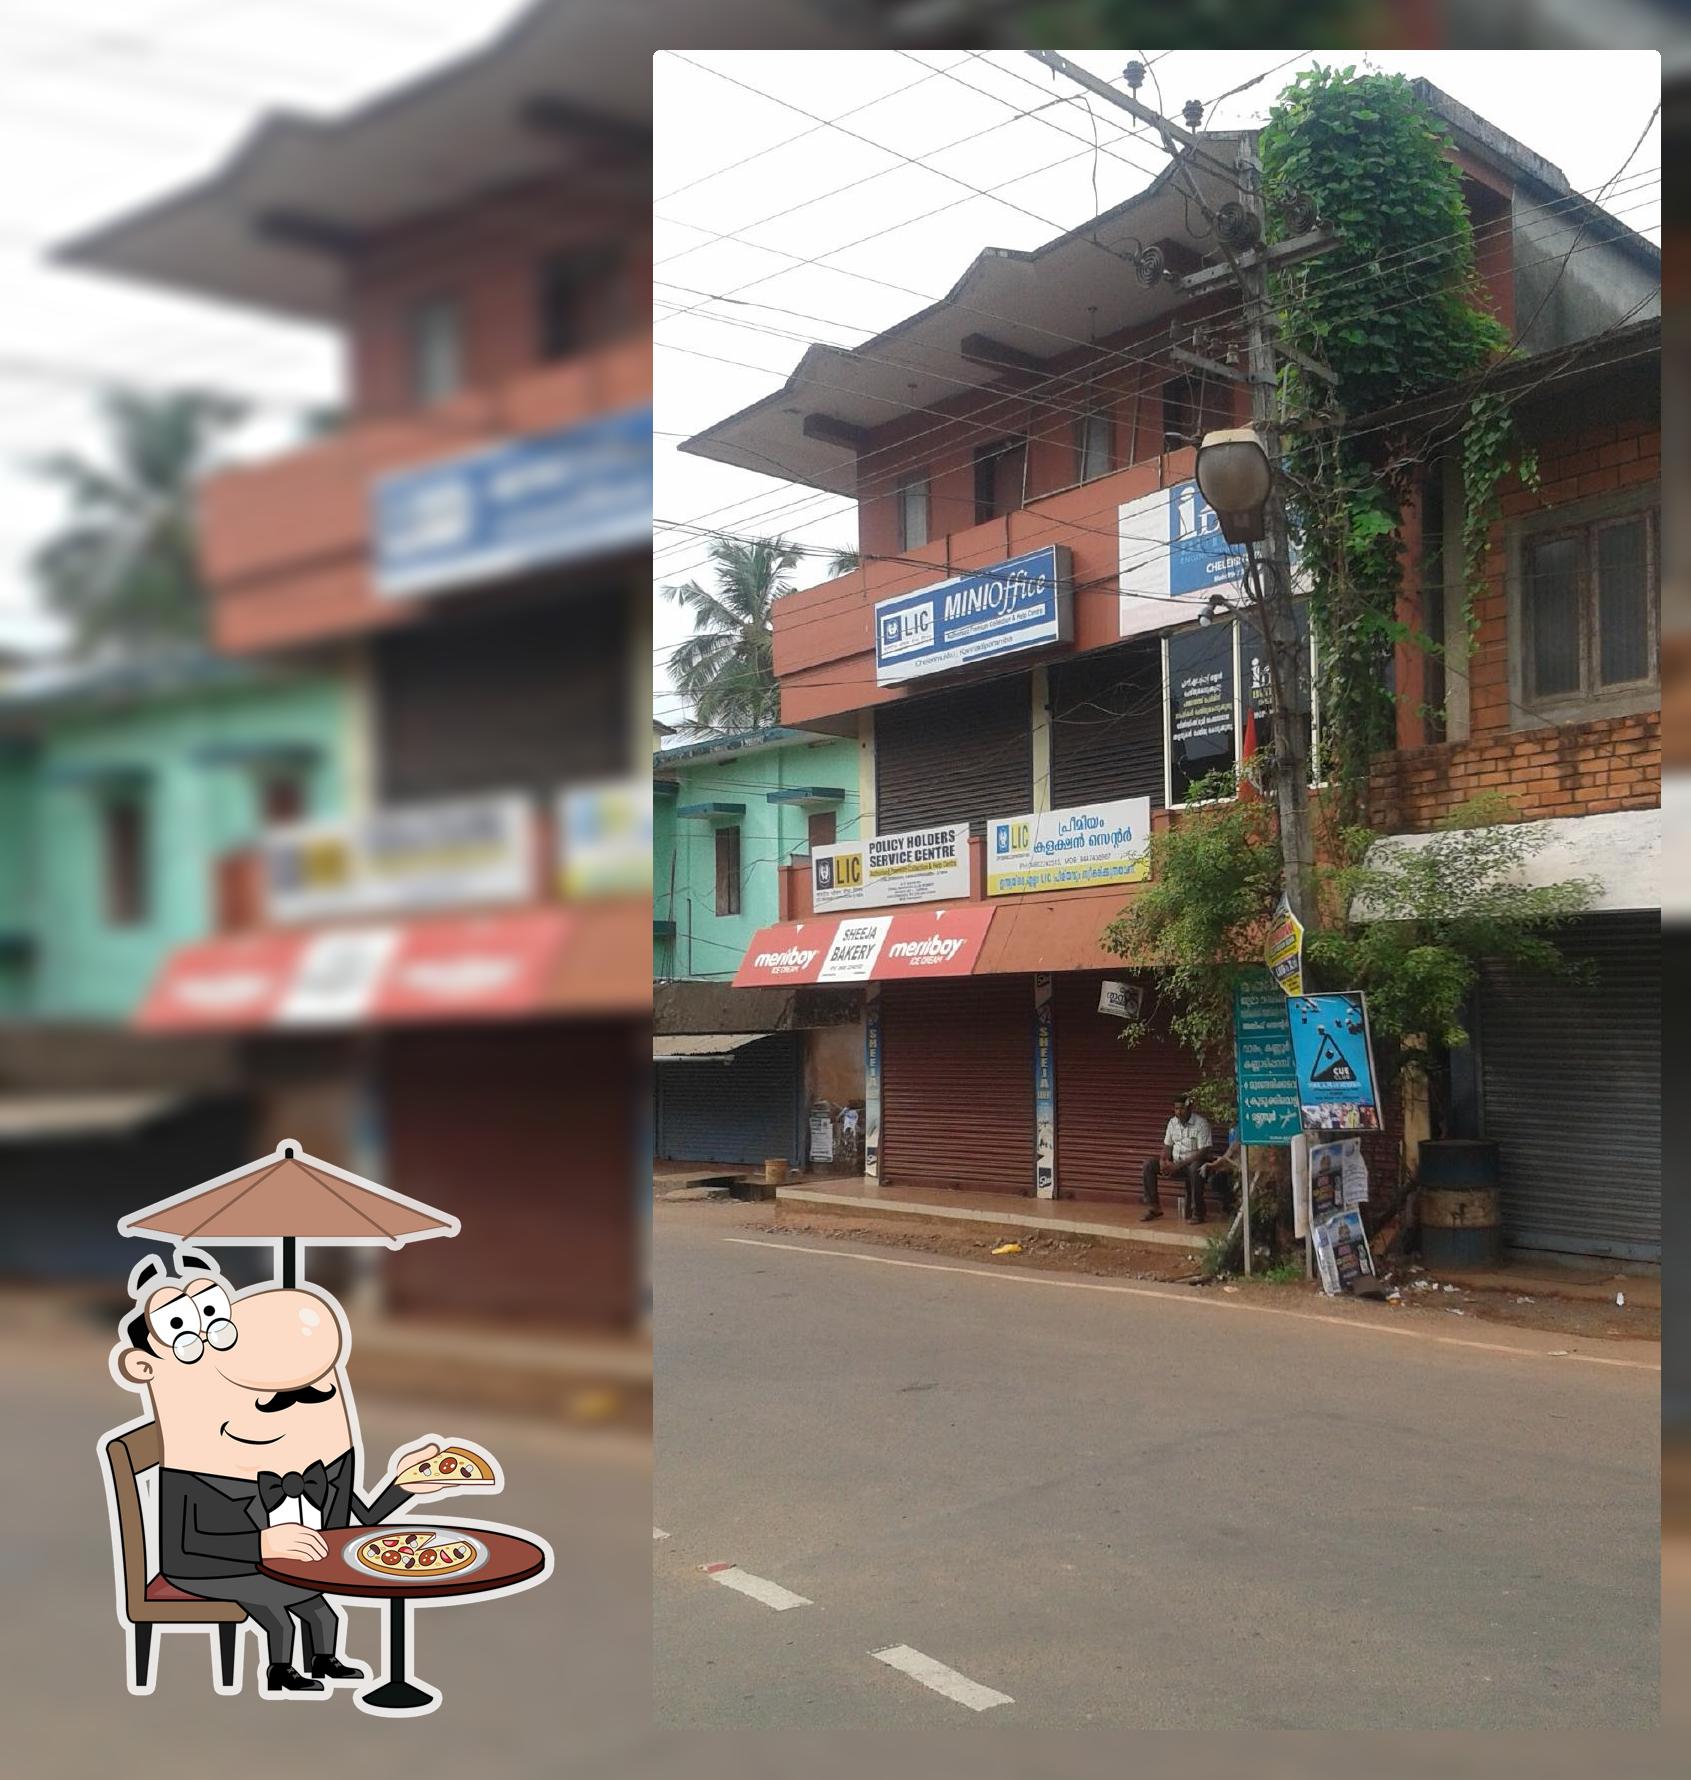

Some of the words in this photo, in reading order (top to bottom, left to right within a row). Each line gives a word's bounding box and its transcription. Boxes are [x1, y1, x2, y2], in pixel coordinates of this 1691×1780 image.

[905, 610, 929, 636] LIC
[1011, 825, 1029, 849] LIC
[1058, 815, 1104, 836] പ്രീമിയം
[869, 837, 905, 854] POLICY
[907, 830, 956, 848] HOLDERS
[870, 850, 912, 868] SERVICE
[914, 845, 956, 862] CENTRE
[836, 857, 860, 884] LIC
[842, 926, 877, 941] SHEEJA
[830, 944, 876, 961] BAKERY
[1039, 1026, 1049, 1089] SHEEJA
[1333, 1066, 1350, 1075] CUE
